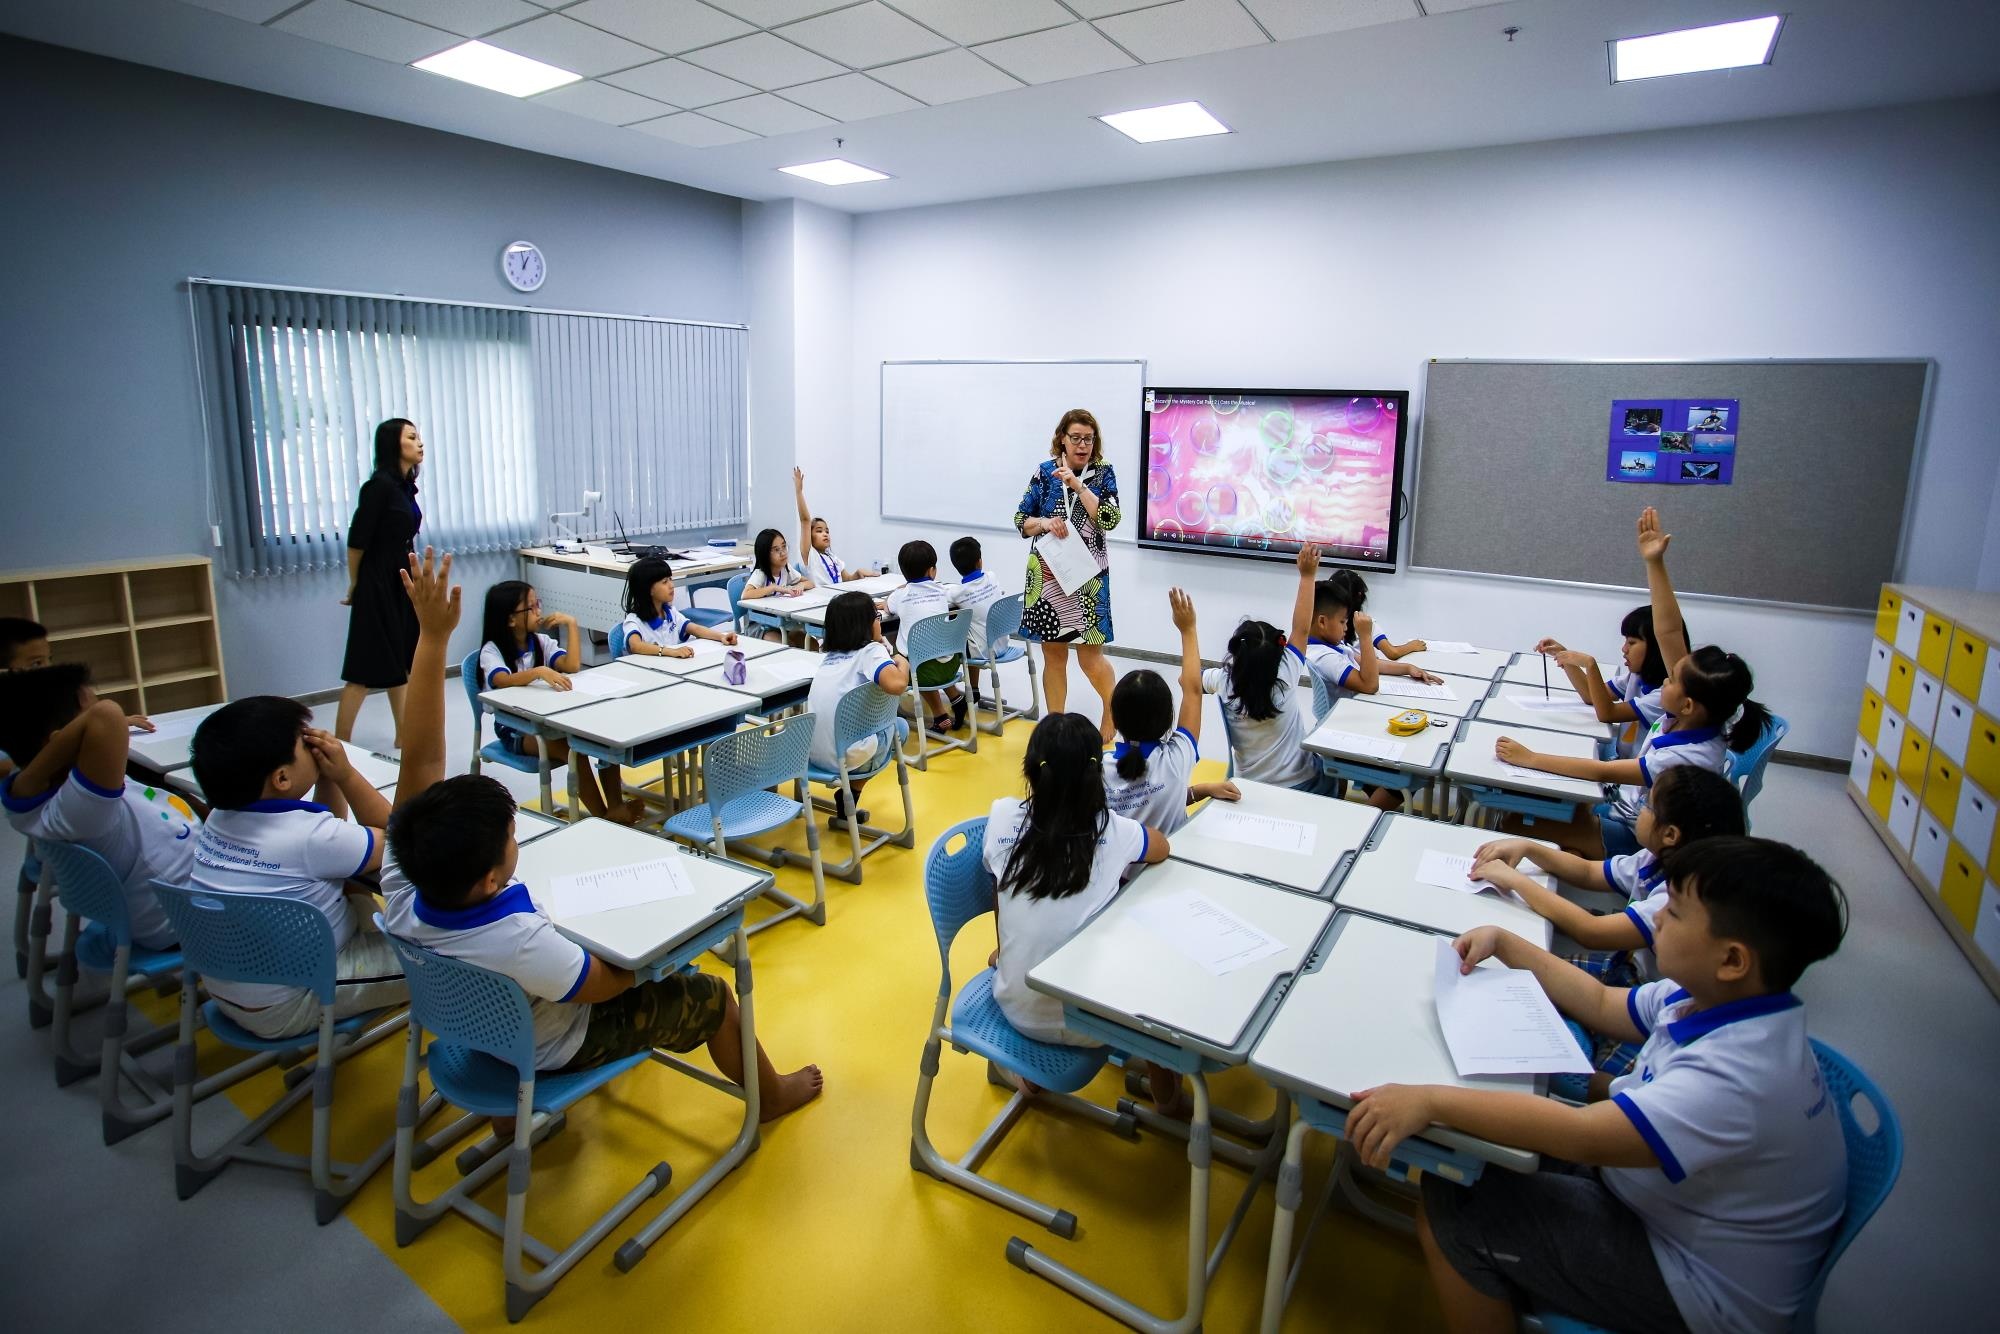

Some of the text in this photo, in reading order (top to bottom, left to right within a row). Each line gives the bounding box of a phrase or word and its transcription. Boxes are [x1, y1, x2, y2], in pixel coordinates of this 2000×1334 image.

[228, 841, 260, 858] University
[213, 849, 251, 866] International
[252, 860, 281, 870] School
